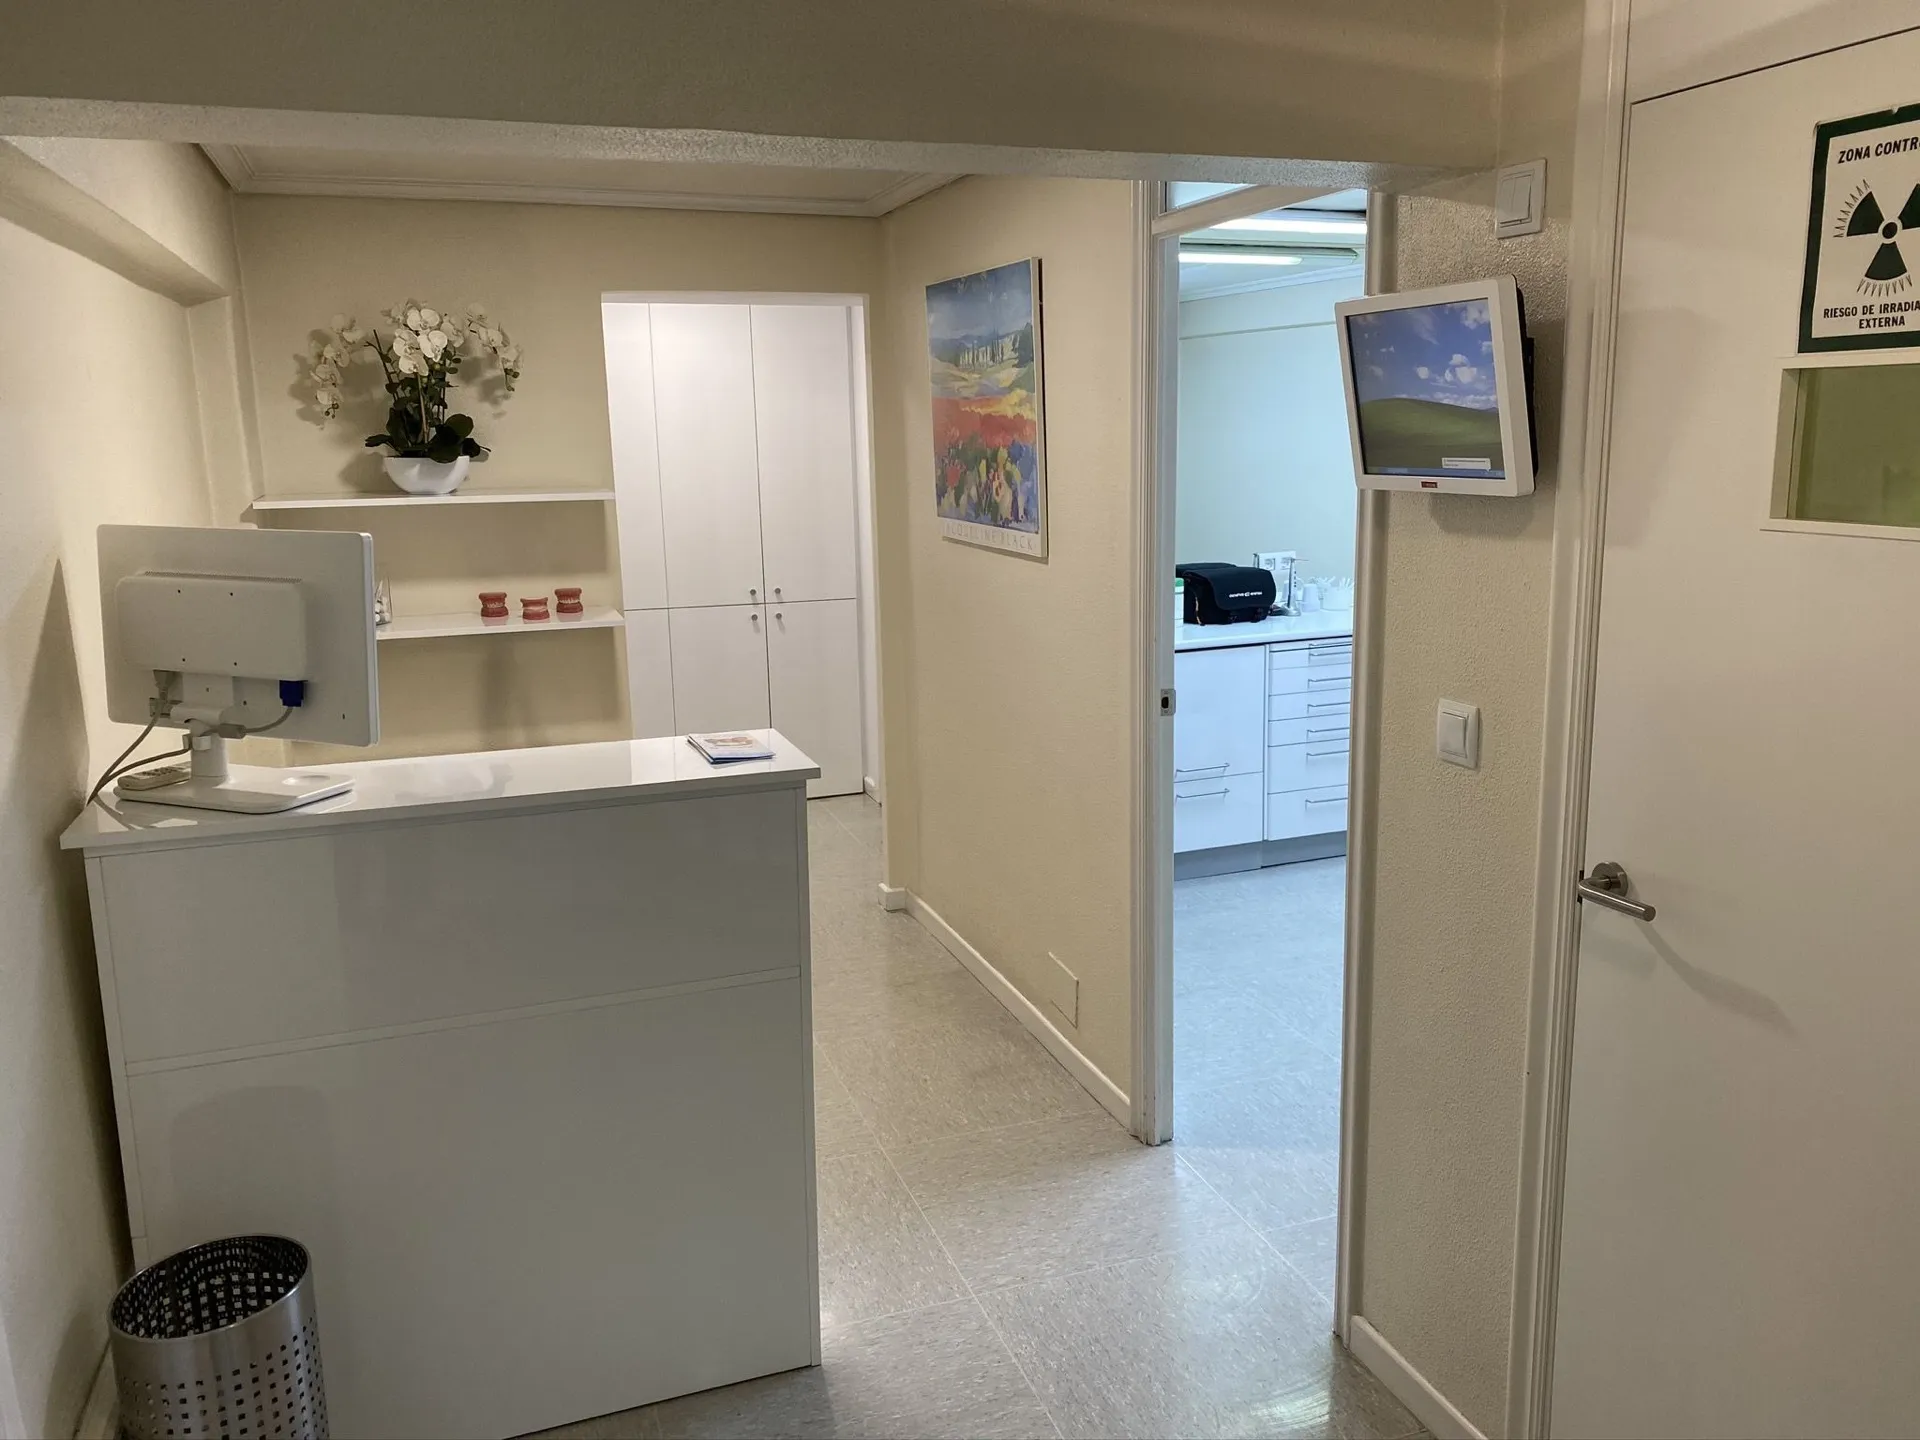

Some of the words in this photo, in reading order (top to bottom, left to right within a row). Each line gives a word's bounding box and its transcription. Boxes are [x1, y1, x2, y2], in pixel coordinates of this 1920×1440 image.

[1838, 145, 1871, 164] ZONA
[1874, 136, 1920, 157] CONTR
[1823, 306, 1858, 319] RIESGO
[1861, 304, 1875, 315] DE
[1879, 300, 1920, 314] IRRADIA
[1858, 315, 1906, 329] EXTERNA
